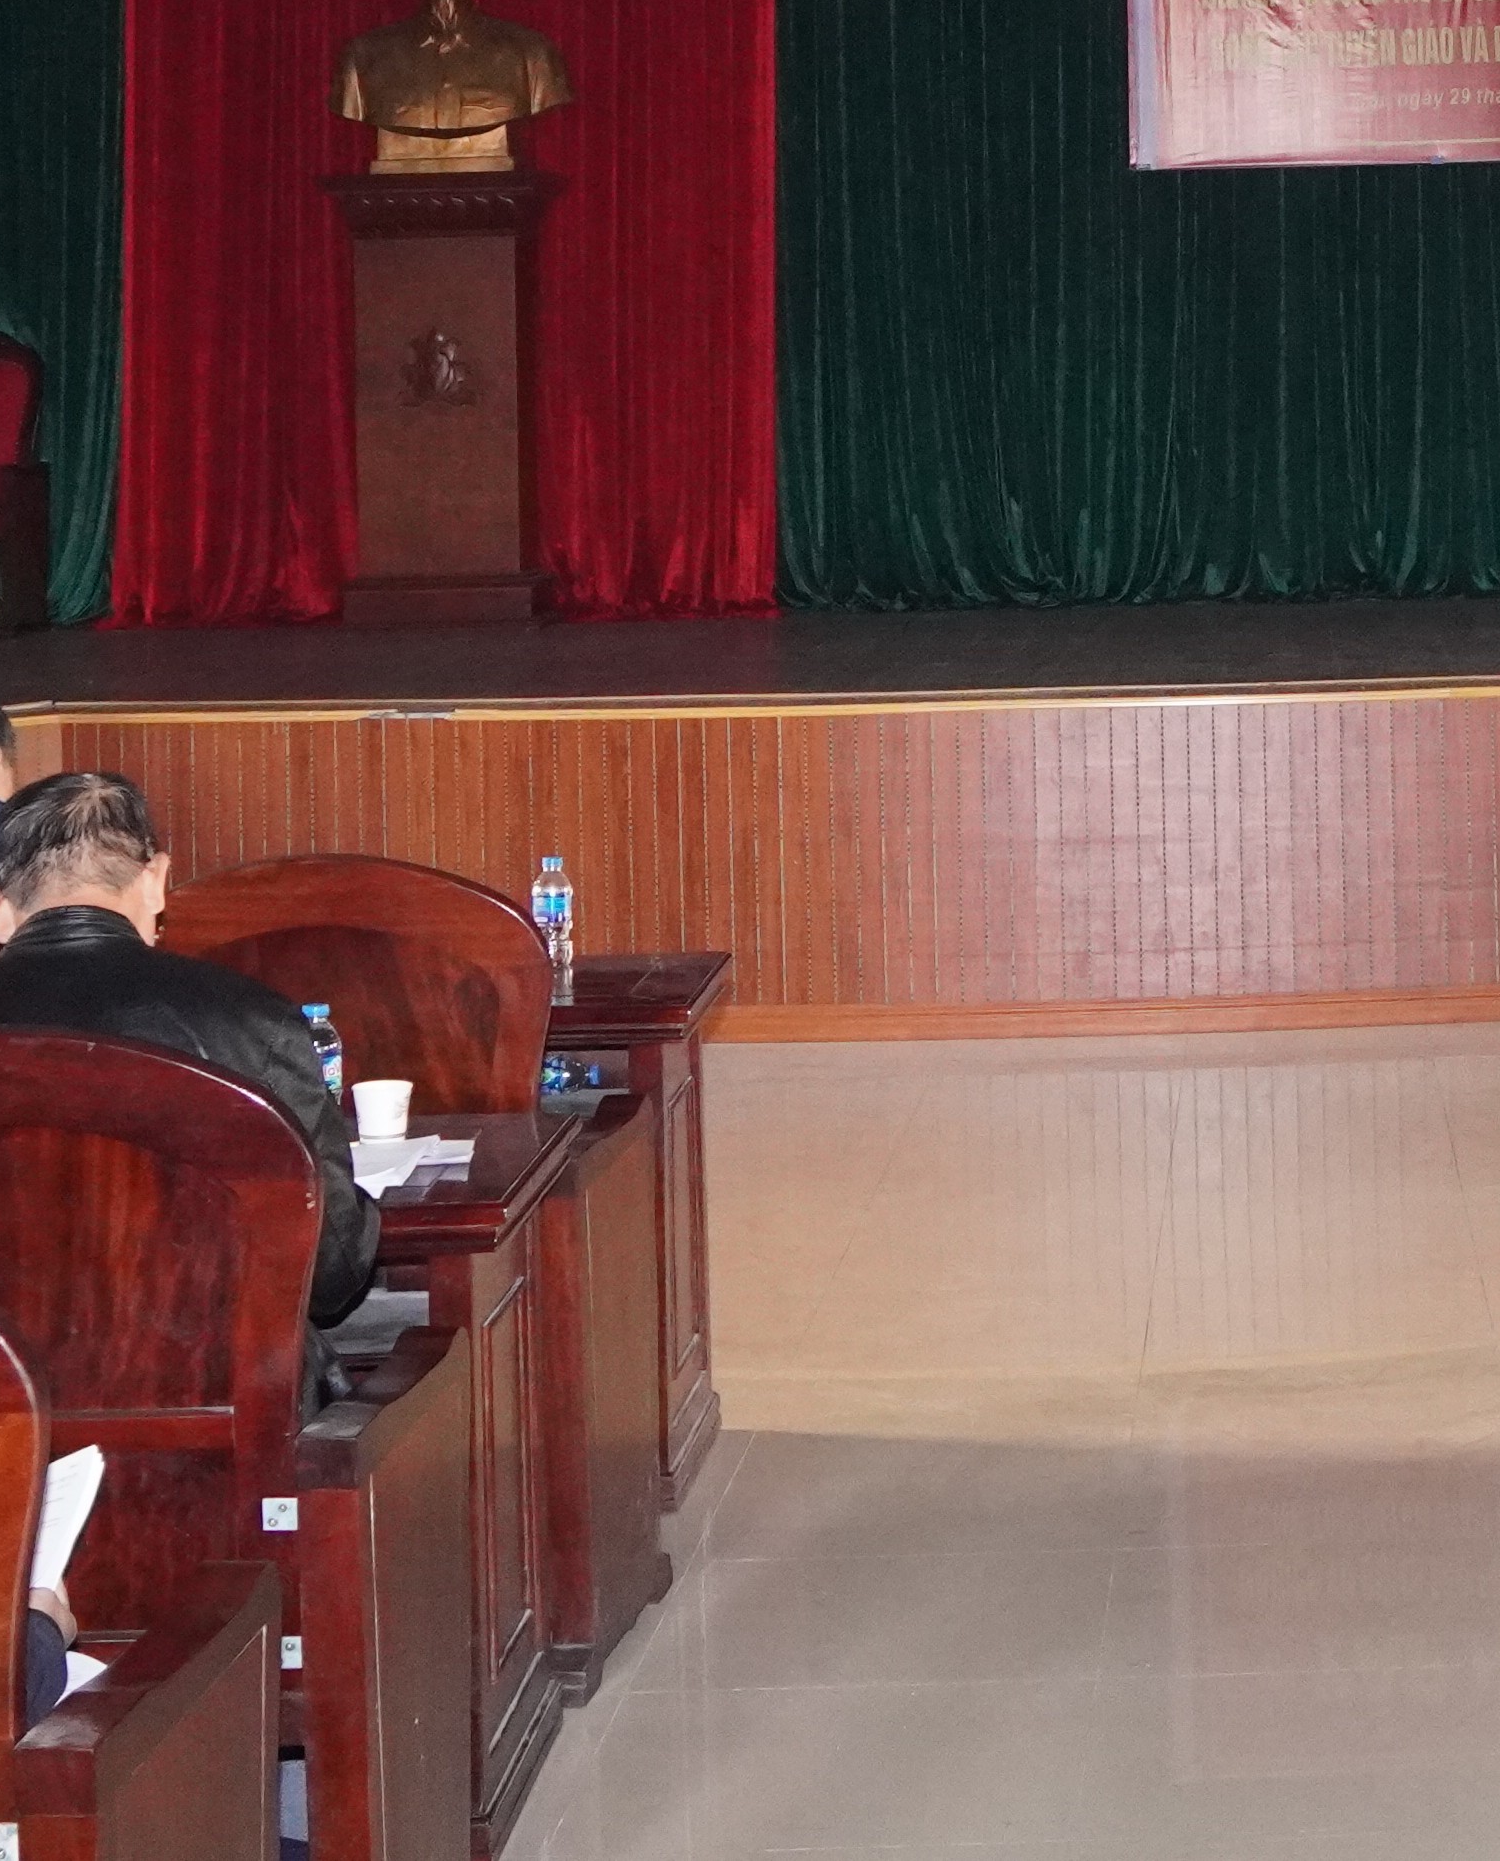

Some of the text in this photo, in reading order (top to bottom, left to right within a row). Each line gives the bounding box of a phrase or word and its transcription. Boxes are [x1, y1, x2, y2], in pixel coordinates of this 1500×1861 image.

[1402, 21, 1454, 66] GIÁO
[1460, 18, 1489, 64] VÀ
[1450, 87, 1471, 106] 29
